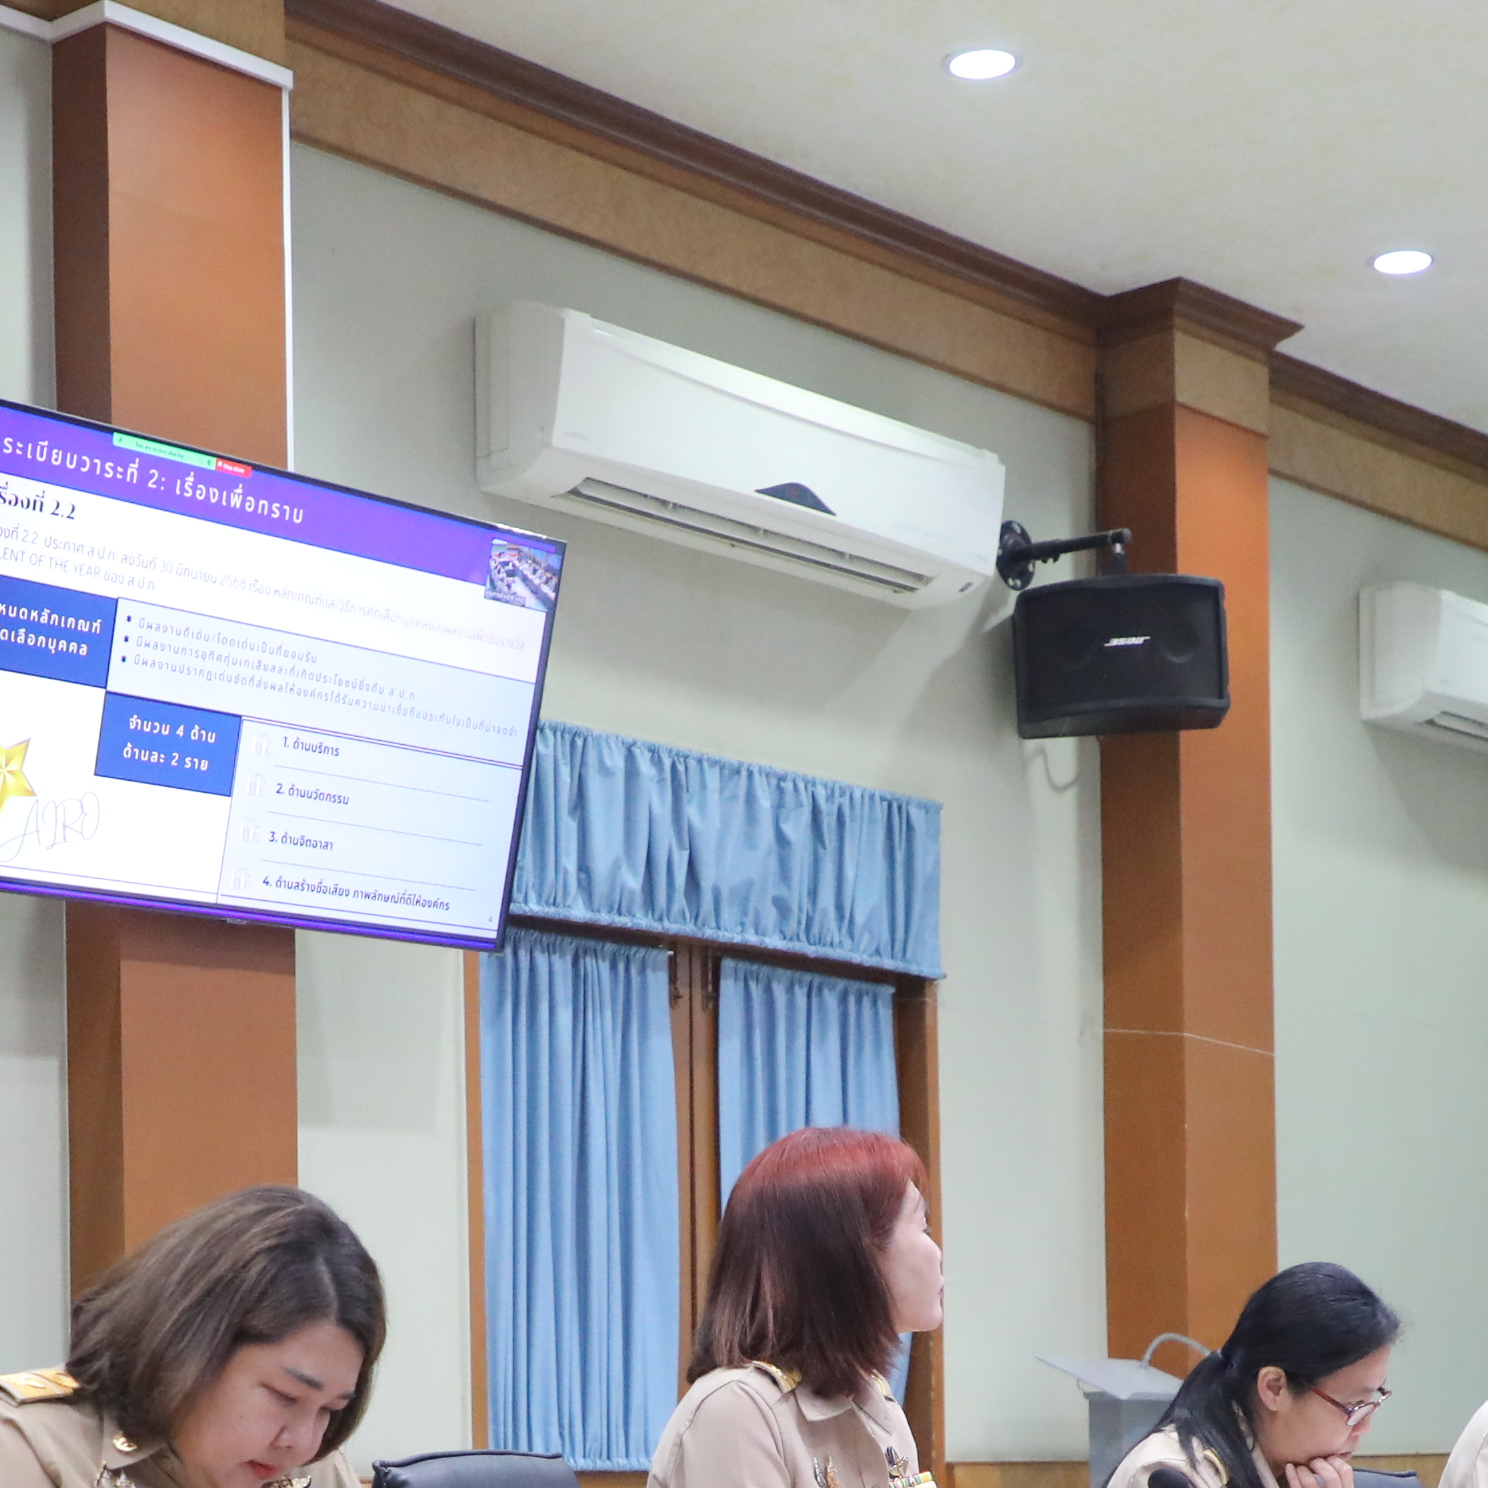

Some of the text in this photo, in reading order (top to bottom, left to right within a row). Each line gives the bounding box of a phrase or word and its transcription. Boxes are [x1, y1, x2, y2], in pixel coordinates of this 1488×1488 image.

[2, 436, 304, 524] ระเบียบวาระที่ 2: เรื่องเพื่อทราบ
[49, 498, 76, 520] 2.2
[44, 534, 85, 555] ประกาศ
[29, 554, 45, 568] OF
[48, 557, 69, 573] THE
[73, 562, 100, 579] YEAR
[104, 571, 124, 586] ของ
[129, 715, 216, 743] จำนวน 4 ด้าน
[123, 742, 209, 771] ด้านละ 2 ราย
[283, 736, 340, 757] 1. ด้านบริการ
[276, 783, 349, 806] 2. ด้านนวัตกรรม
[269, 831, 334, 852] 3. ด้านจิตอาสา
[262, 875, 272, 887] 4.
[275, 876, 350, 898] ด้านสร้างชื่อเสียง
